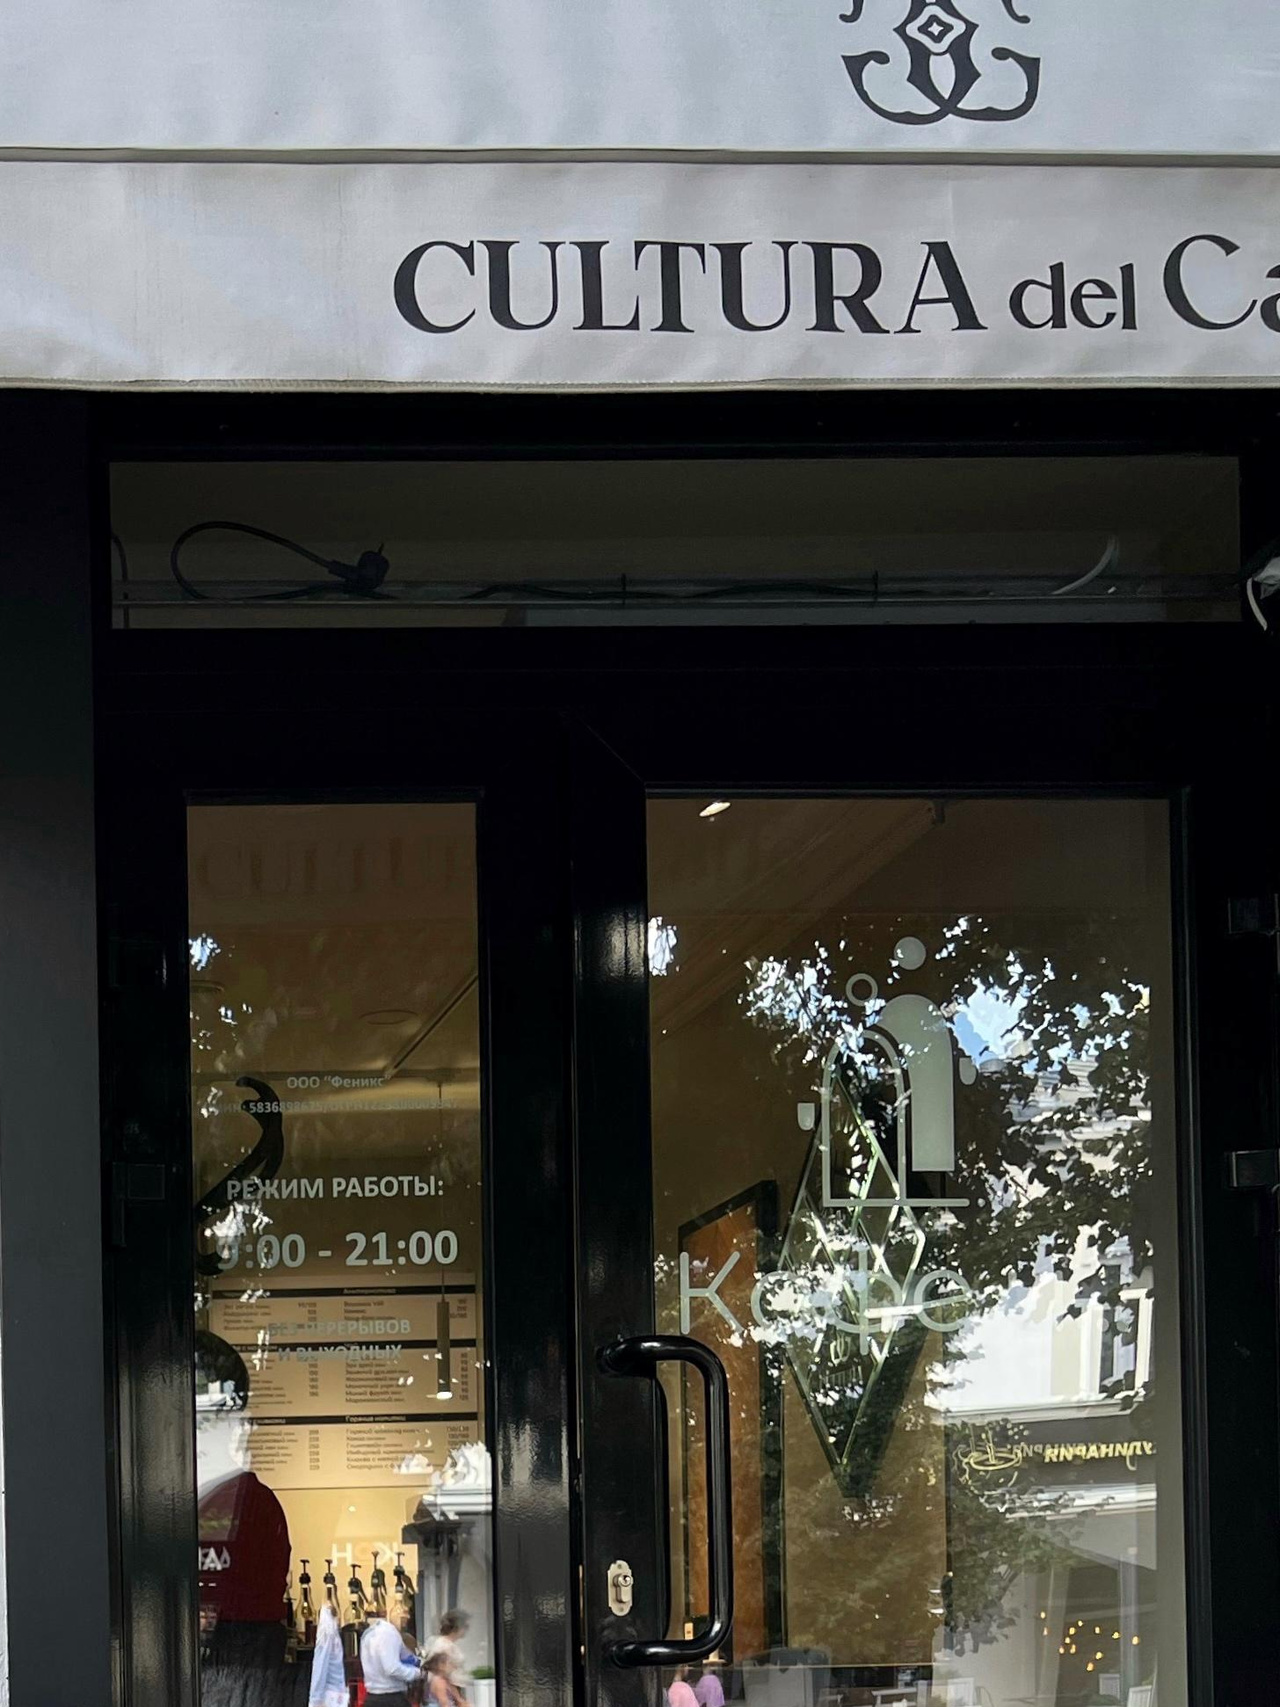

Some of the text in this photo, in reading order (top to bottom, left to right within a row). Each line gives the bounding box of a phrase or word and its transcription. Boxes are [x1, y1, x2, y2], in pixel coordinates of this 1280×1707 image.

[393, 240, 988, 335] CULTURA
[1008, 262, 1137, 331] del
[286, 1076, 320, 1089] ООО
[227, 1176, 444, 1200] РЕЖИМ РАБОТЫ:
[345, 1230, 458, 1267] 21:00
